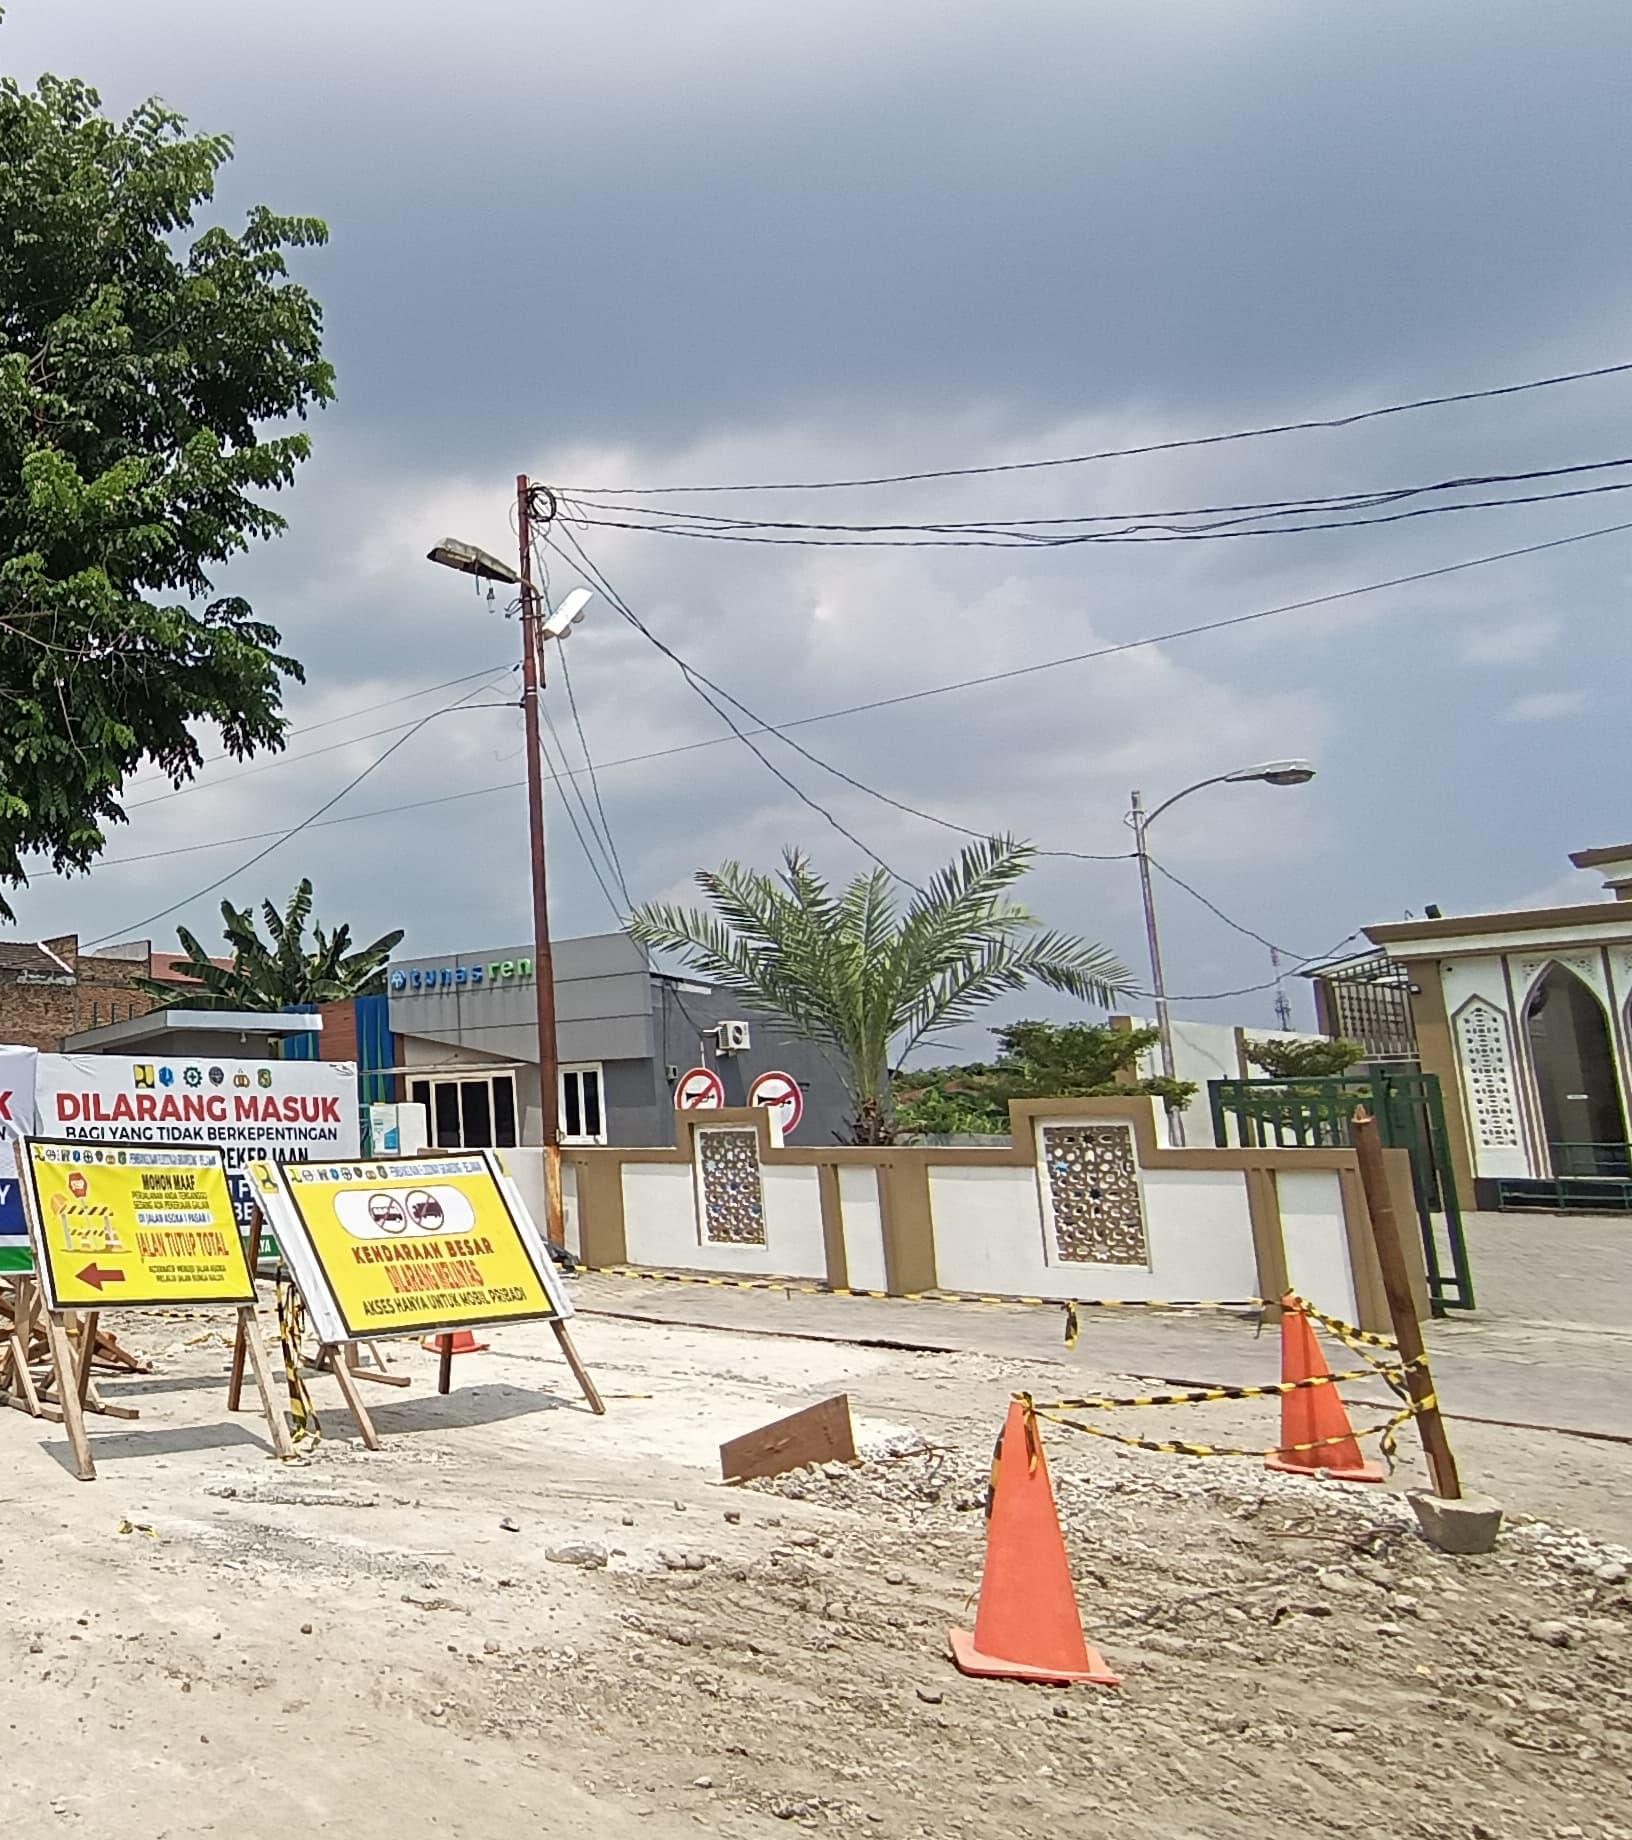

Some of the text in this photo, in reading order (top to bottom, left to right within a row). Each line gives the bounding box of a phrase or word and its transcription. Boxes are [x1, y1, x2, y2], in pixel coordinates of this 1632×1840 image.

[56, 1093, 341, 1123] DILARANG MASUK
[109, 1126, 153, 1140] YANG
[156, 1127, 204, 1140] TIDAK
[208, 1127, 337, 1141] BERKEPENTINGAN
[142, 1174, 196, 1190] MOHON MAAF
[146, 1214, 164, 1224] JALAN
[136, 1232, 230, 1260] JALAN TUTUP TOTAL
[352, 1238, 494, 1264] KENDARAAN BESAR
[384, 1260, 484, 1294] DILARANG MELINTAS
[363, 1286, 528, 1316] AKSES HANYA UNTUK MOBIL PRIBADI
